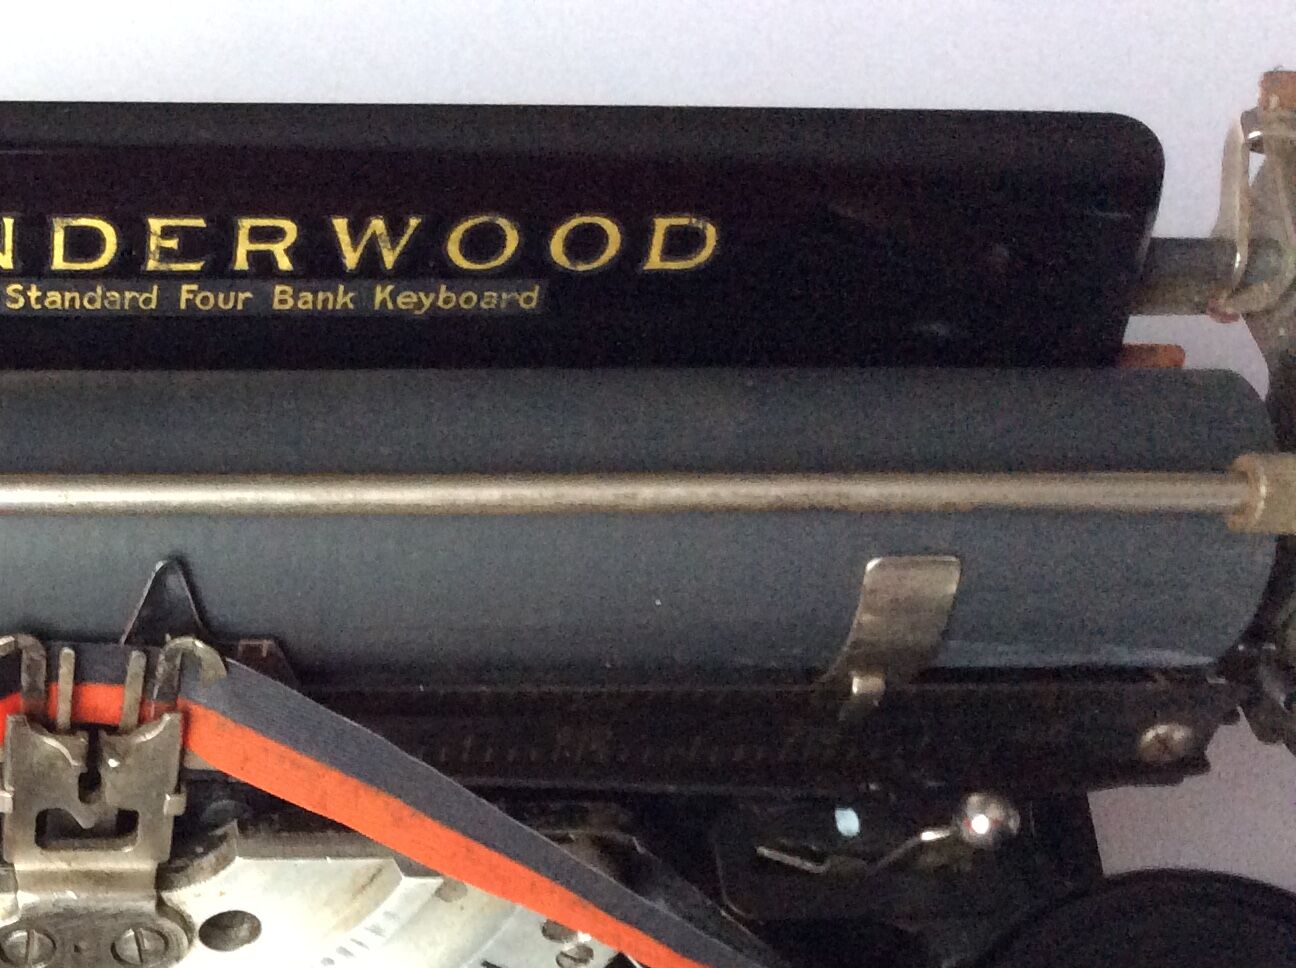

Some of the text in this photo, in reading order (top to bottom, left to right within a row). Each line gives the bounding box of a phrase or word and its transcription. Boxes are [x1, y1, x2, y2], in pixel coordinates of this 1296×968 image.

[4, 283, 540, 315] Standard Four Bank Keyboard
